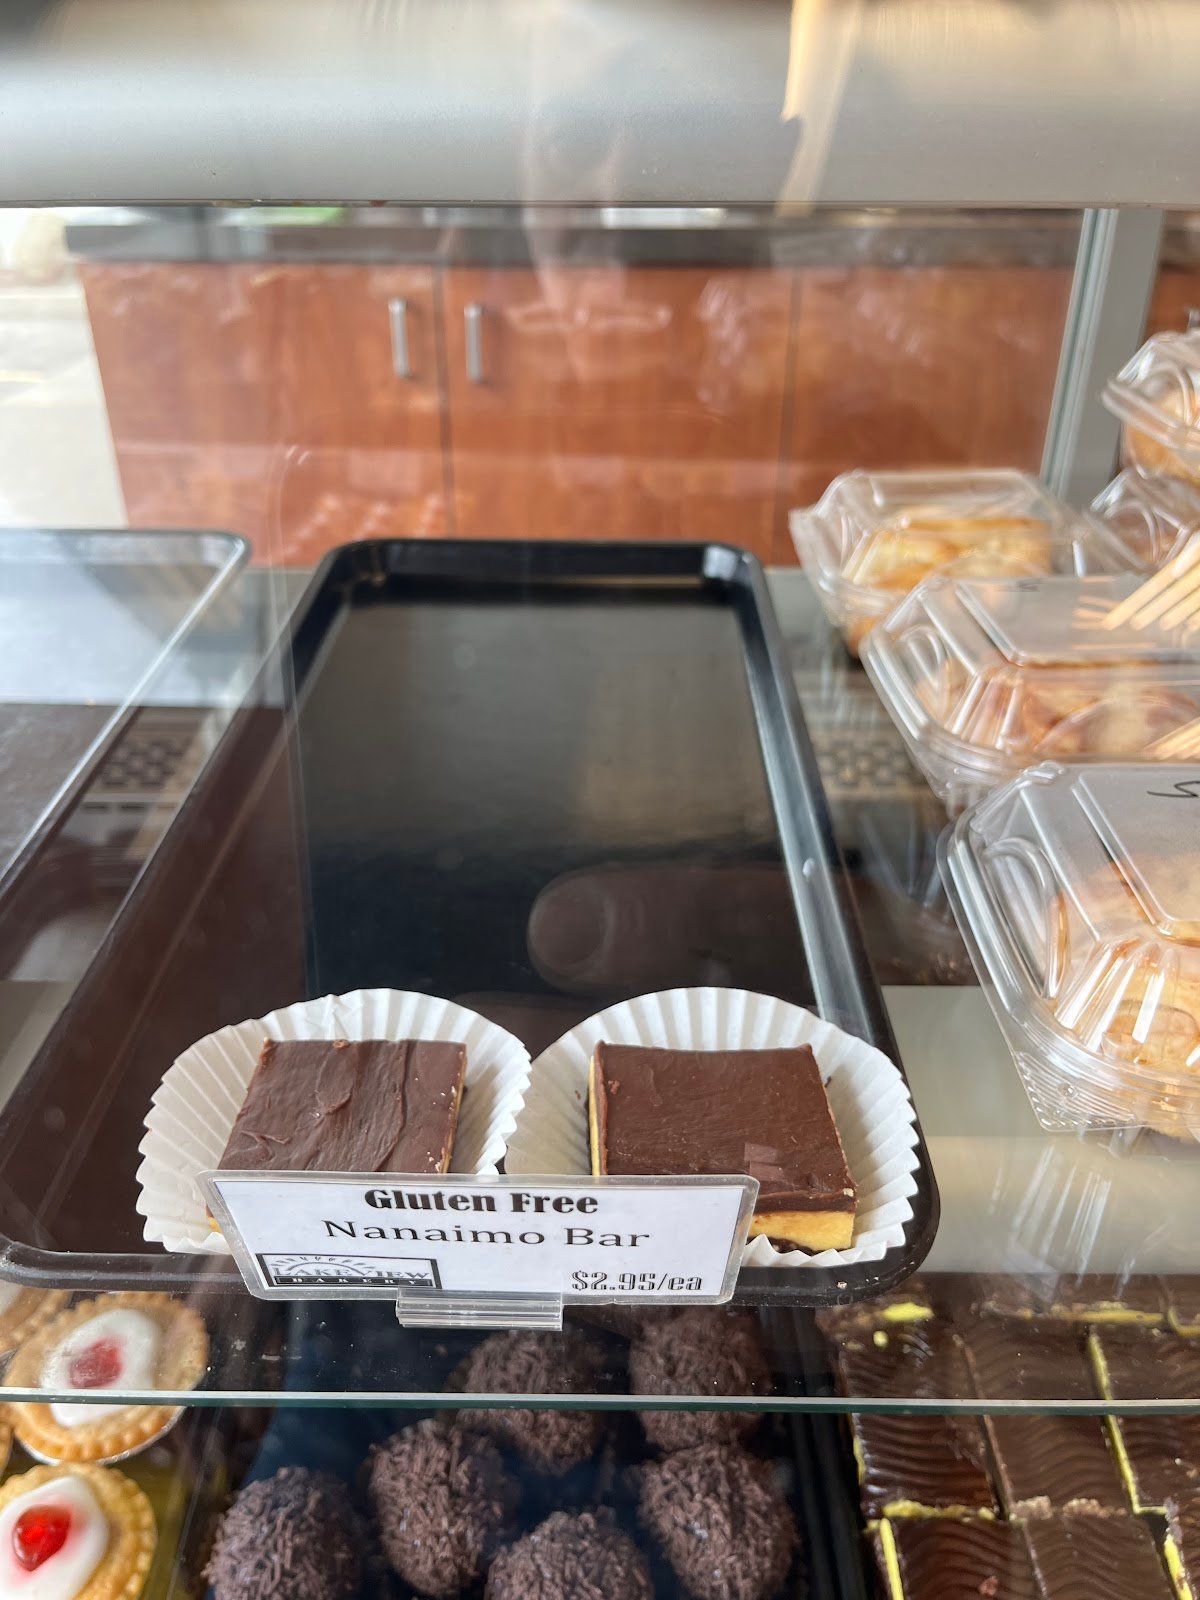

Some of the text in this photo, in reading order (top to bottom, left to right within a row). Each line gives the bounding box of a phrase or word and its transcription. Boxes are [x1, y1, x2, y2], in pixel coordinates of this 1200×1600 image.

[364, 1189, 598, 1214] Gluten Free
[321, 1219, 650, 1247] Nanaimo Bar
[272, 1267, 430, 1279] LAKEVIEW
[292, 1277, 416, 1285] BAKERY
[571, 1270, 702, 1291] $2.95/ea
